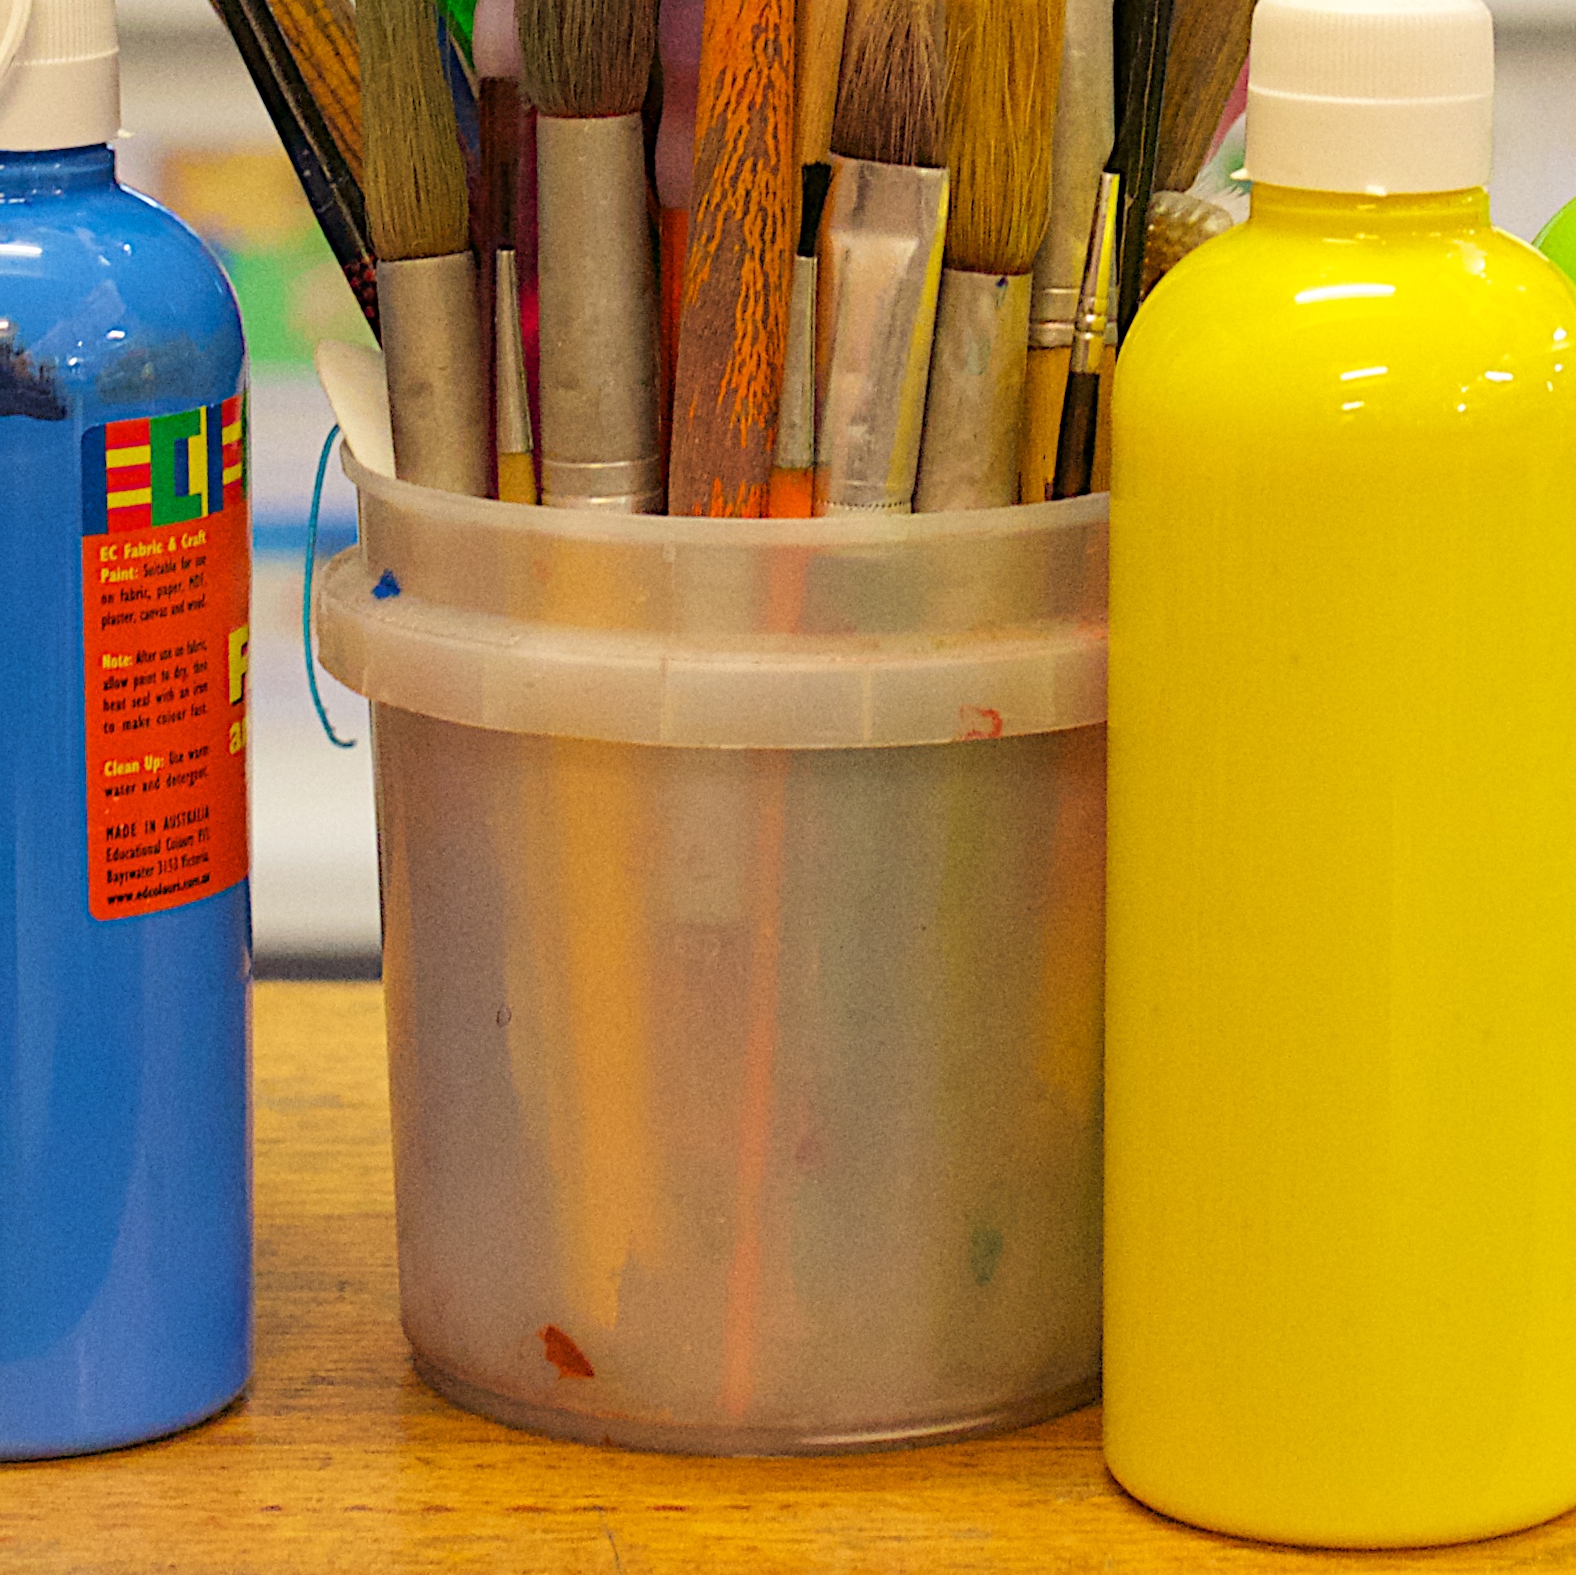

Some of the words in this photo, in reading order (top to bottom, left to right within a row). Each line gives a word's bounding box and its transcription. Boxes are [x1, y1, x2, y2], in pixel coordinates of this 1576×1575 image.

[100, 545, 117, 562] EC
[124, 539, 163, 559] Fabric
[167, 536, 177, 552] &
[181, 529, 207, 548] Craft
[100, 567, 138, 583] Paint:
[143, 559, 176, 578] Suitable
[181, 556, 191, 570] for
[101, 594, 114, 604] on
[120, 586, 151, 602] fabric,
[101, 613, 136, 630] plaster,
[140, 607, 167, 621] canvas
[171, 601, 185, 615] and
[102, 654, 133, 669] Note:
[136, 649, 156, 664] After
[103, 676, 128, 691] allow
[133, 672, 156, 691] paint
[161, 670, 169, 681] to
[103, 699, 126, 712] heat
[132, 692, 151, 708] seal
[156, 688, 175, 703] with
[193, 681, 209, 696] iron
[103, 722, 115, 734] to
[122, 716, 150, 731] make
[156, 710, 186, 725] colour
[104, 760, 140, 777] Clean
[144, 754, 165, 774] Up:
[169, 750, 184, 765] Use
[187, 745, 209, 759] warm
[105, 783, 136, 797] water
[142, 777, 160, 793] and
[106, 823, 137, 841] MADE
[144, 820, 156, 834] IN
[163, 806, 210, 830] AUSTRALIA
[106, 839, 162, 863] Educational
[106, 866, 155, 886] Bayswater
